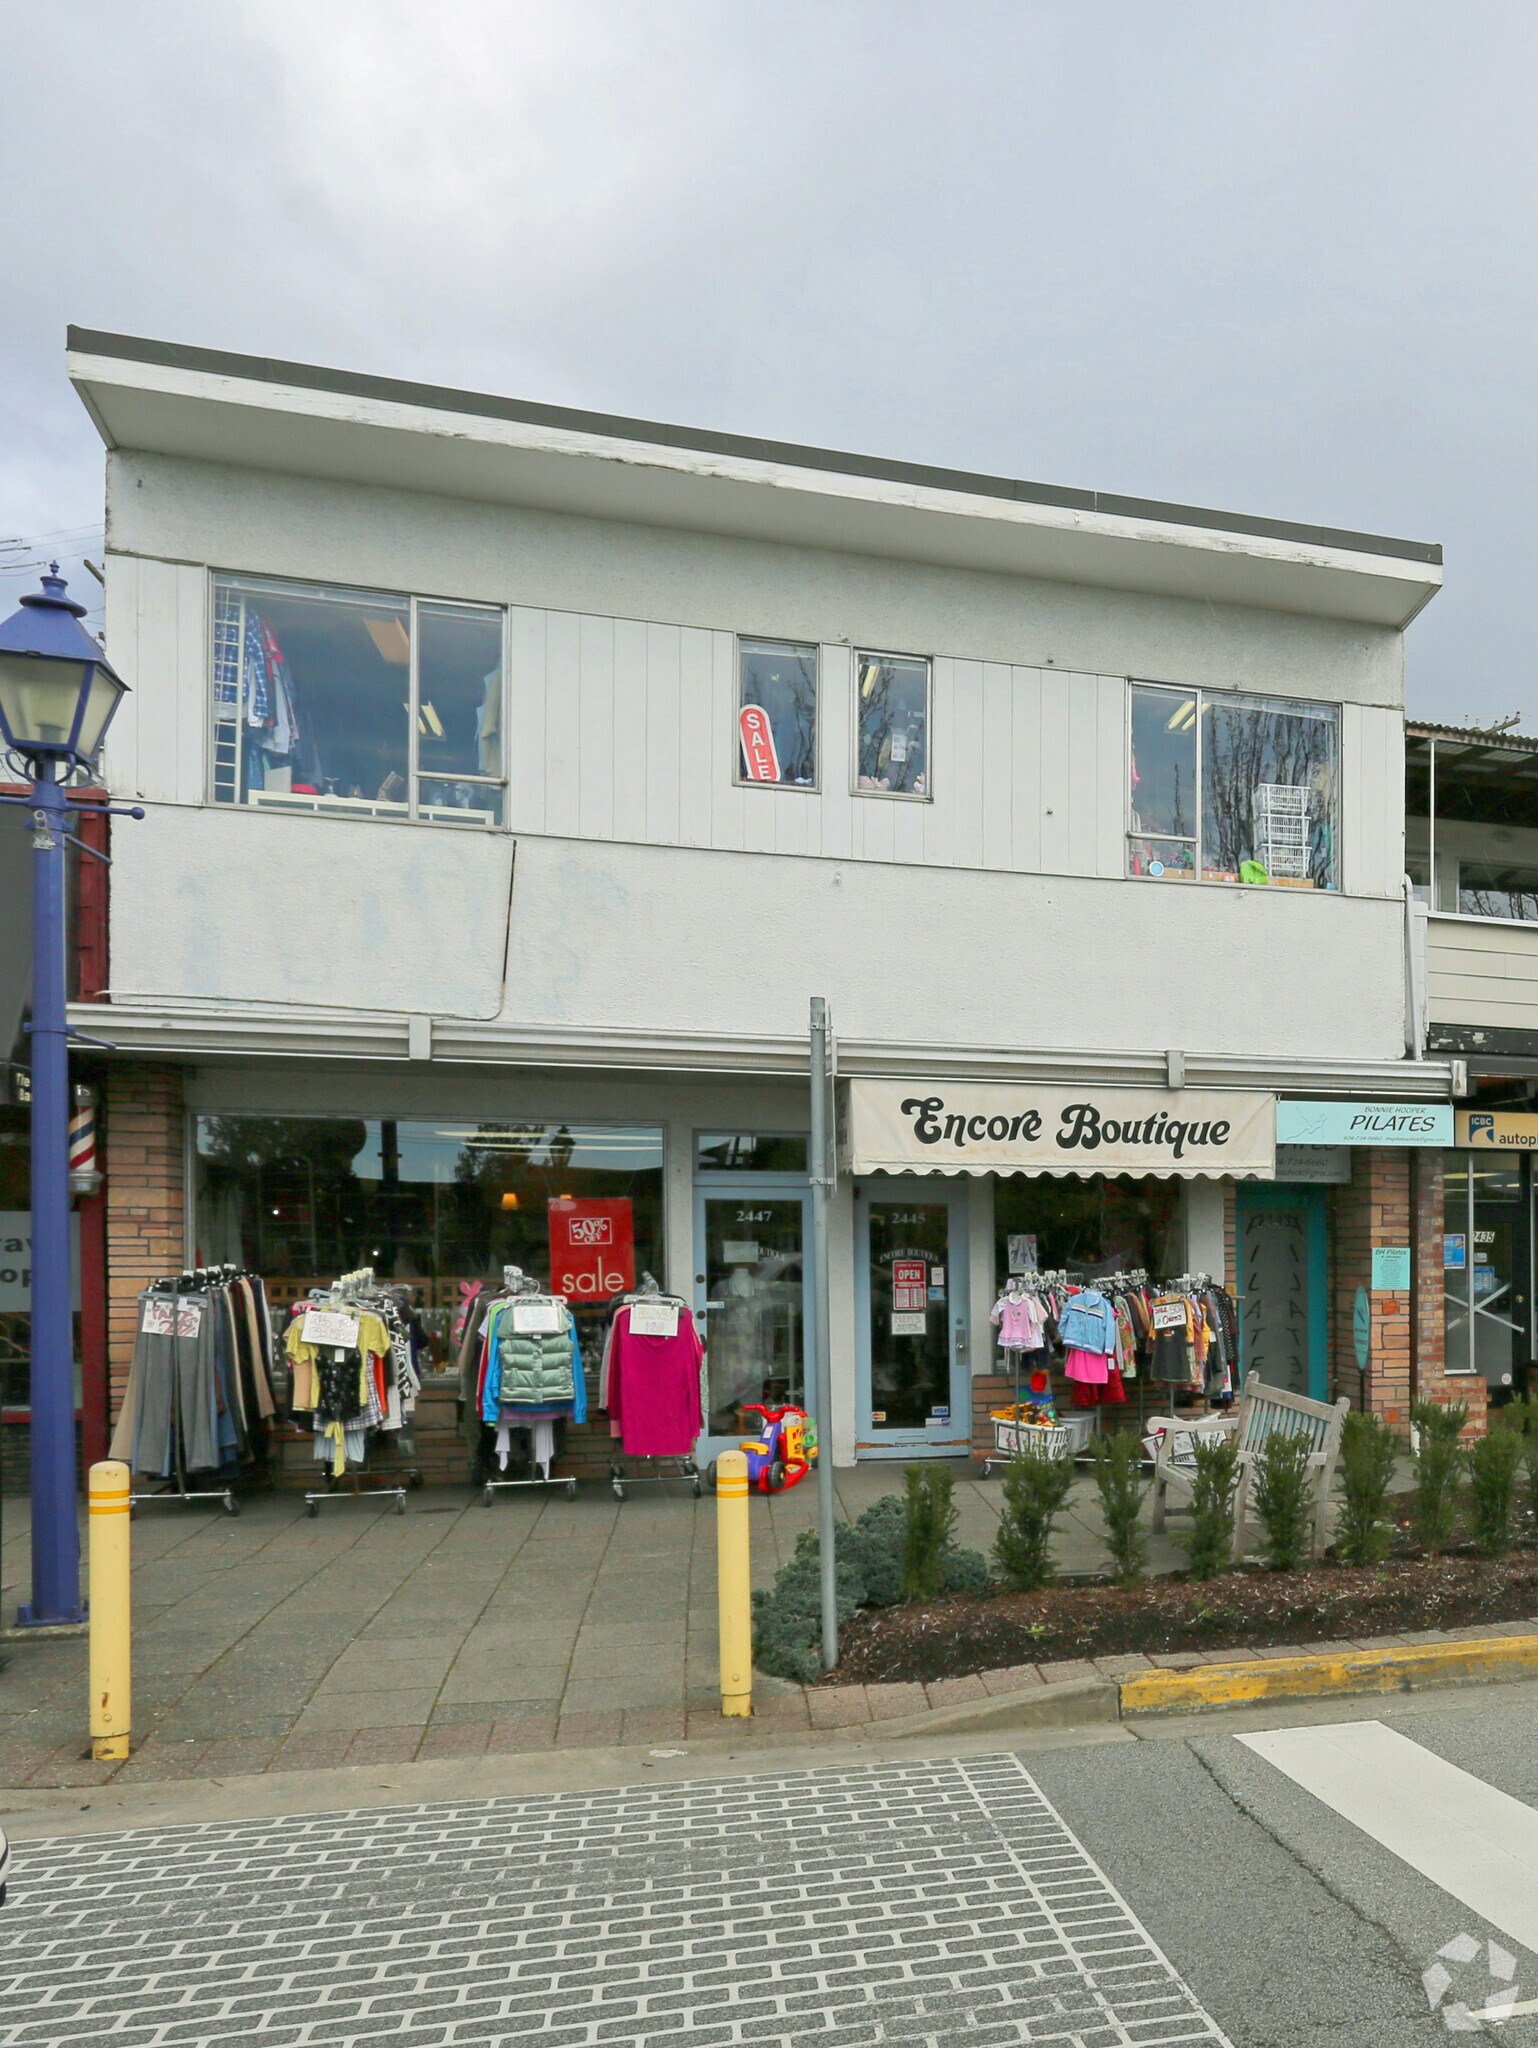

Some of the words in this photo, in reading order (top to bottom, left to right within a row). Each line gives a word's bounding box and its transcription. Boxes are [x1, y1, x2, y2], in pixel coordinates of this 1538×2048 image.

[746, 713, 772, 780] SALE
[901, 1097, 1042, 1147] Encore
[1056, 1103, 1230, 1159] Boutique
[1350, 1114, 1436, 1132] PILATES
[1471, 1117, 1492, 1126] ICBC
[1499, 1133, 1538, 1147] autop
[736, 1210, 772, 1222] 2447
[891, 1212, 927, 1225] 2445
[571, 1219, 608, 1239] 50%
[584, 1232, 602, 1244] OFF
[562, 1256, 624, 1293] sale
[898, 1269, 920, 1280] OPEN
